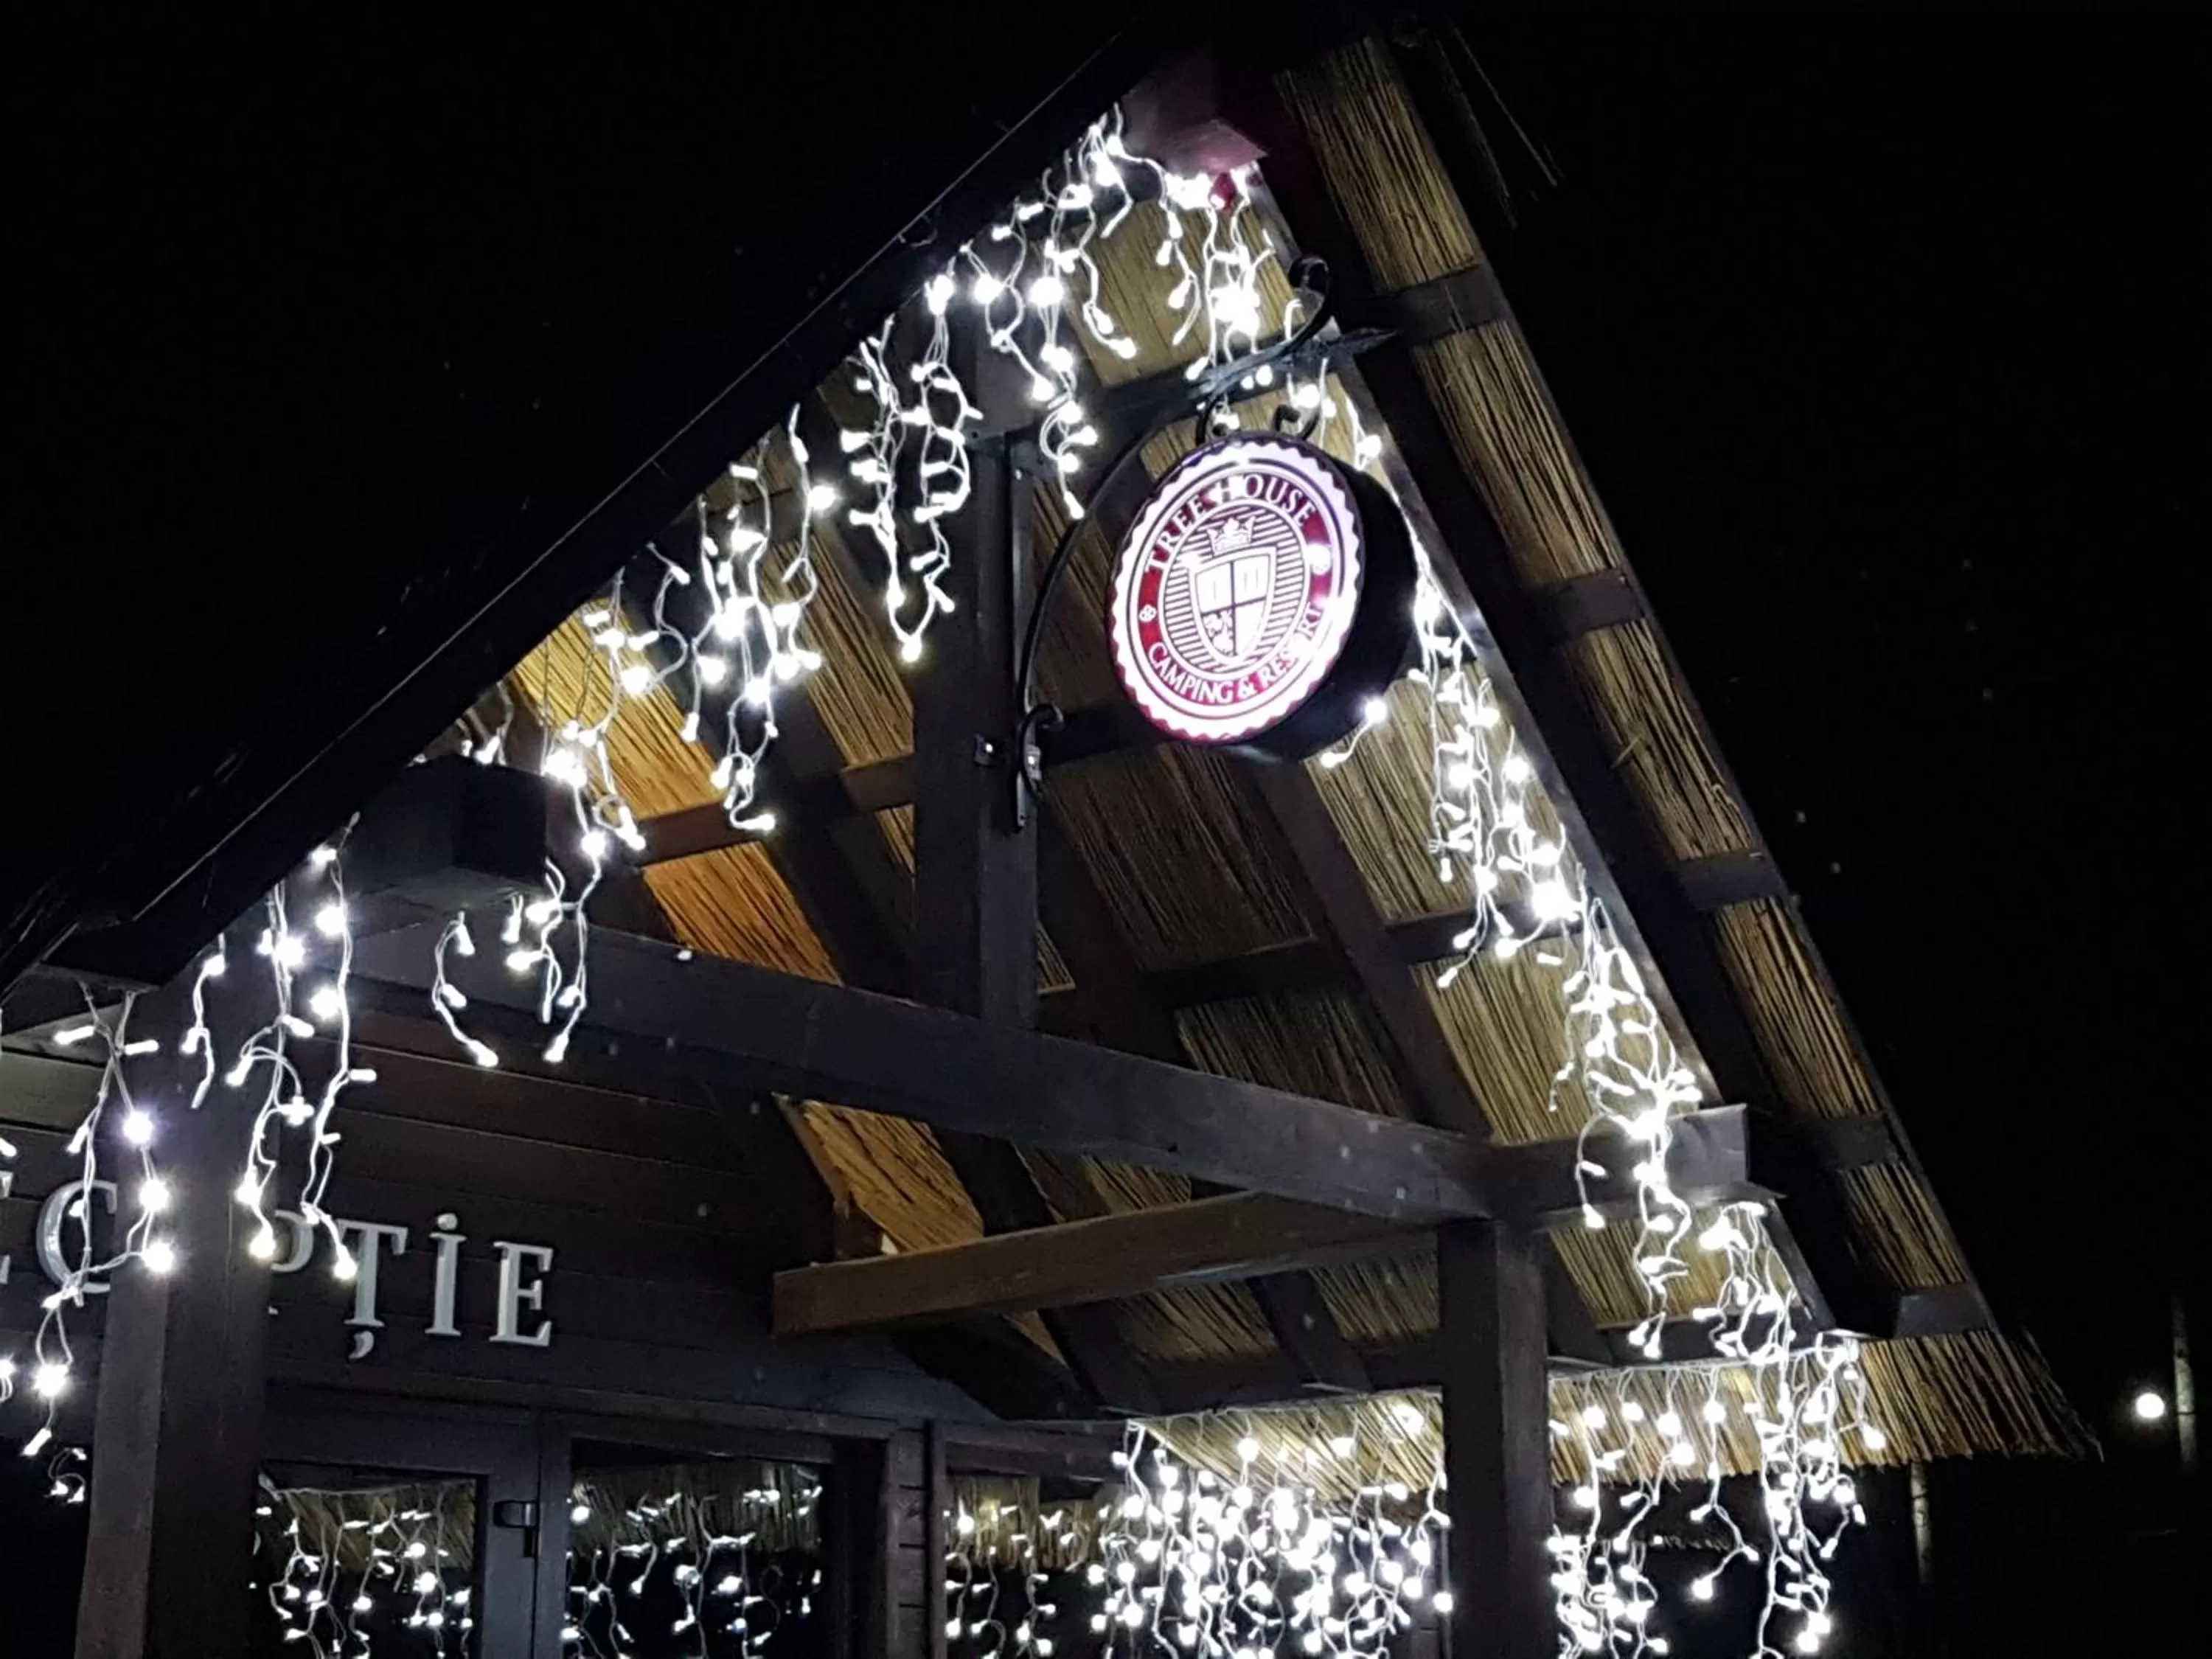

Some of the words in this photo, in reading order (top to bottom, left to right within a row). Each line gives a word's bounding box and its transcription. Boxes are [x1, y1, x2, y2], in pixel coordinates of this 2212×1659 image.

[1144, 495, 1210, 573] TREE
[1149, 641, 1234, 703] CAMPING
[1237, 675, 1258, 699] &
